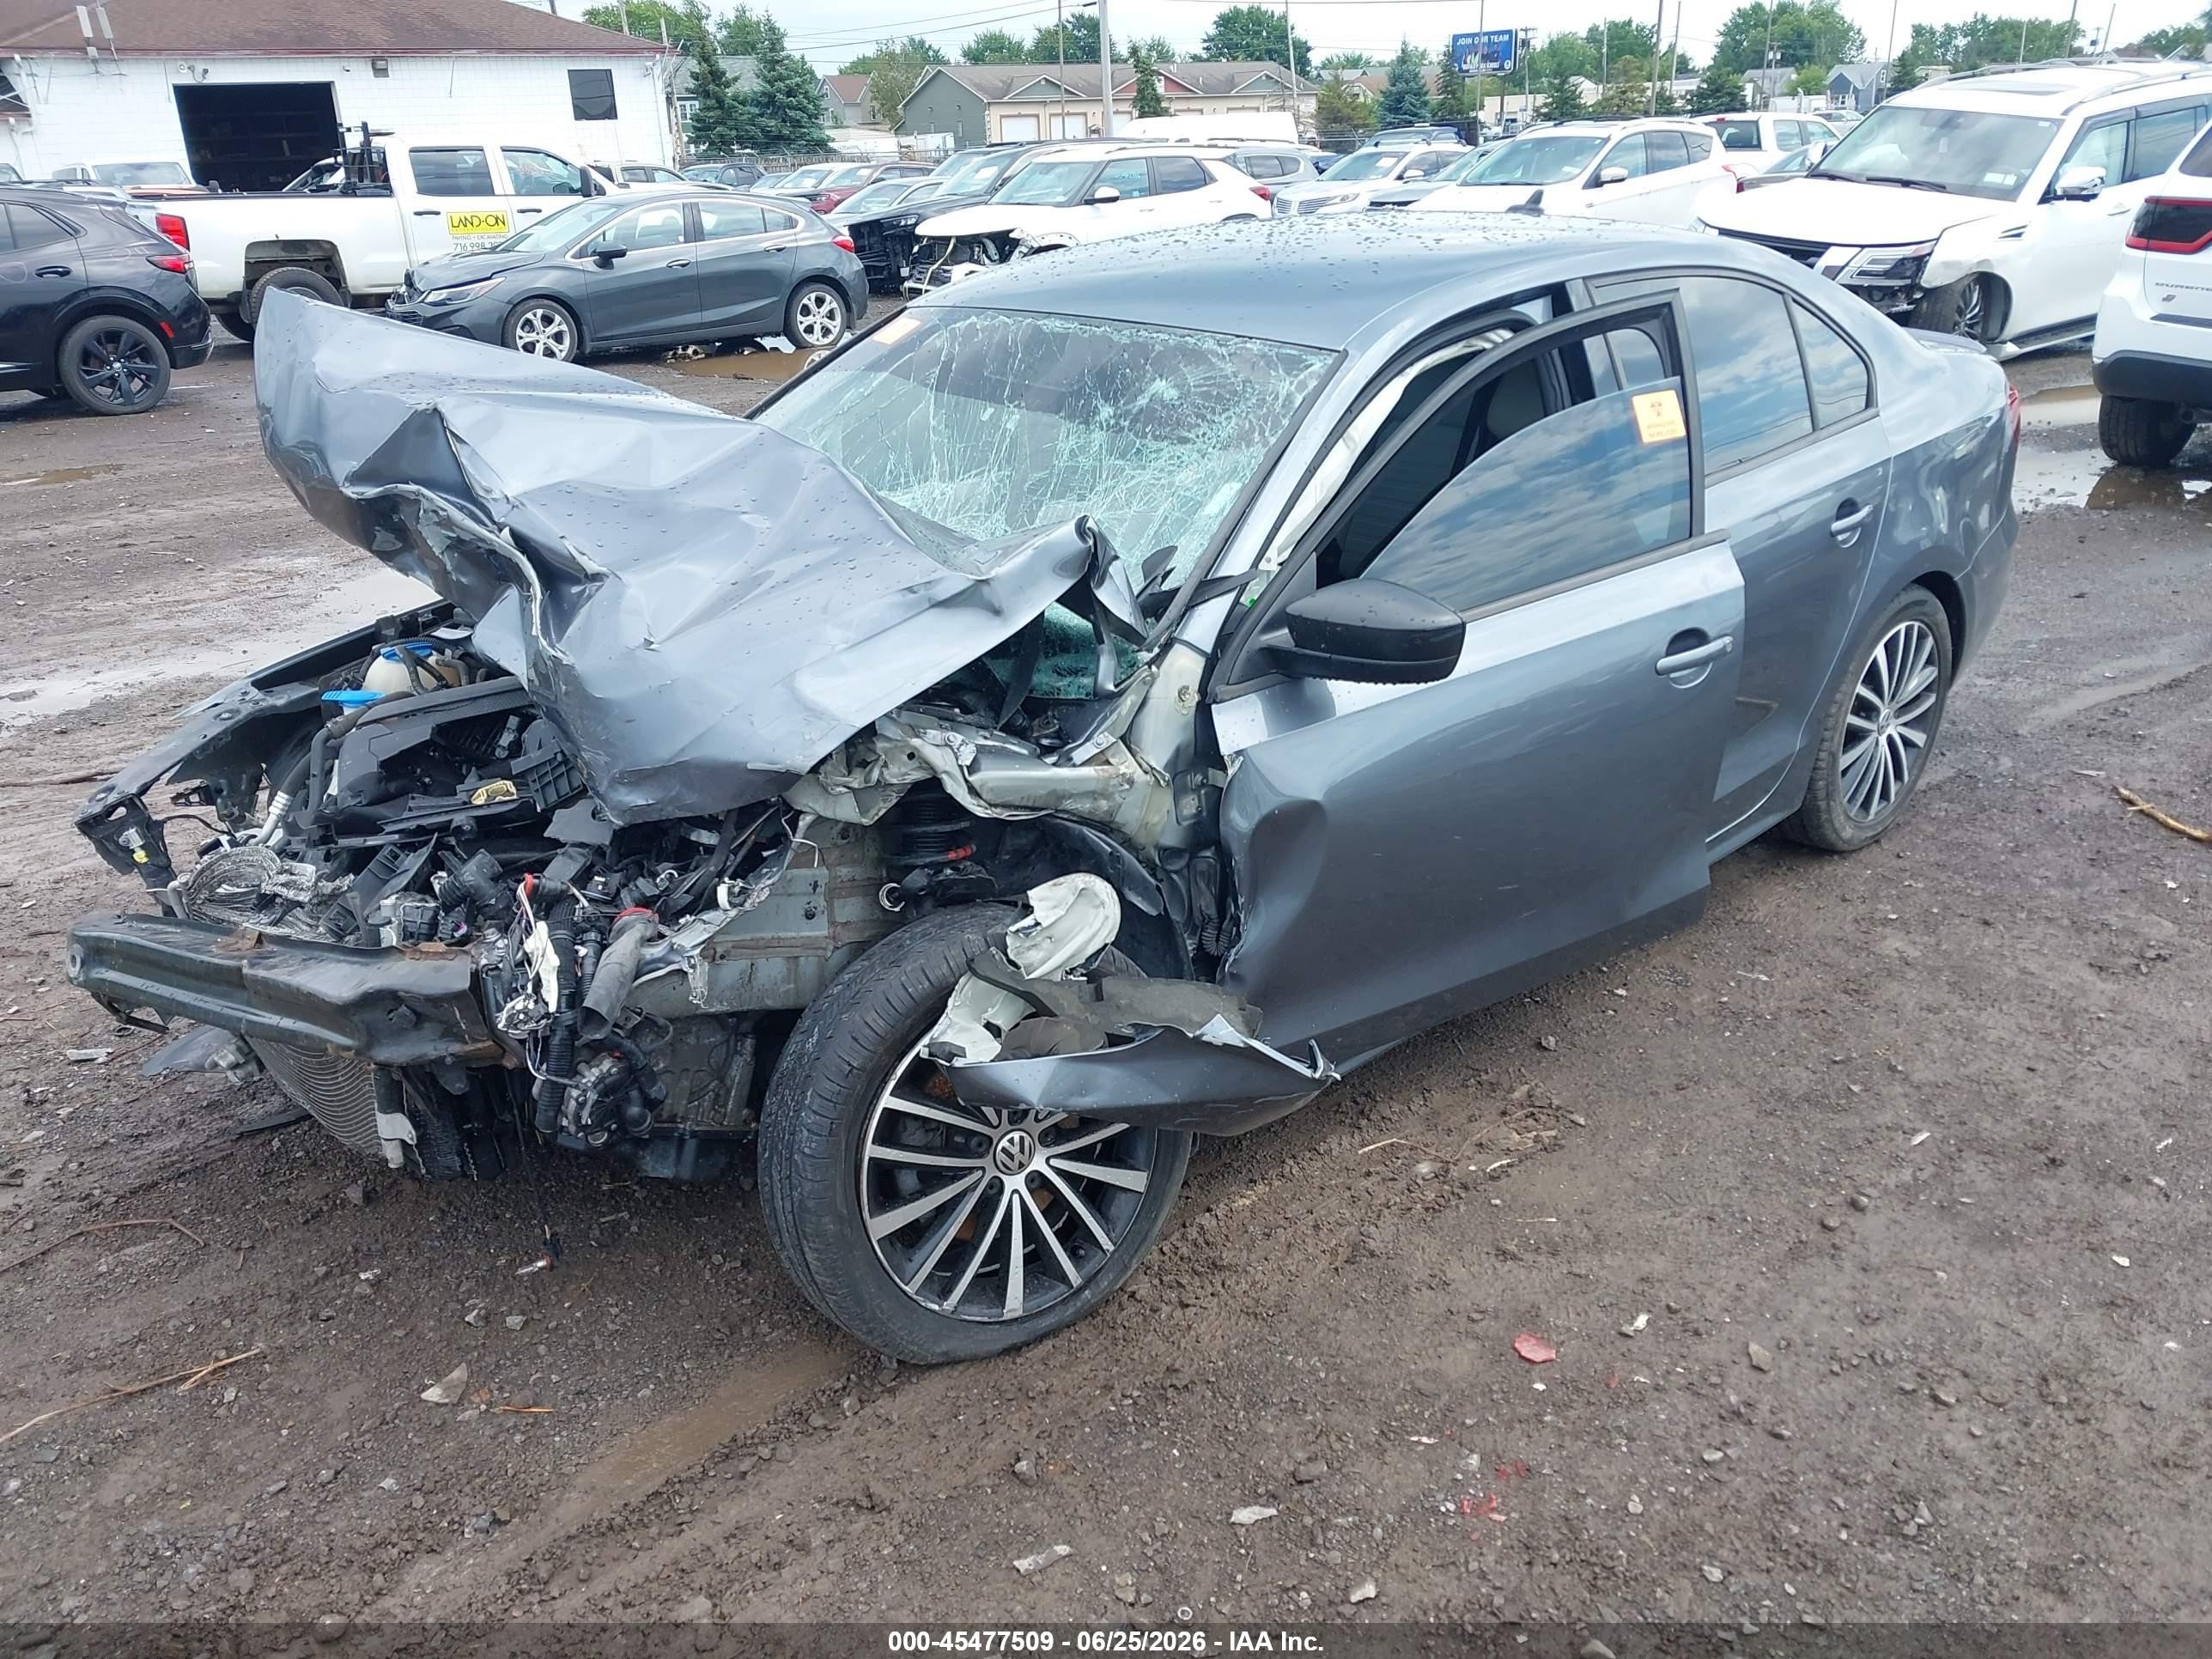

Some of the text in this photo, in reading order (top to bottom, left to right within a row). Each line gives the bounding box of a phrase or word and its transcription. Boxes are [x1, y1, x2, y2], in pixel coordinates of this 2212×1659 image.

[1457, 37, 1473, 46] JOIN
[1490, 33, 1510, 42] TEAM
[450, 214, 506, 228] LAND-ON
[453, 242, 468, 252] 716
